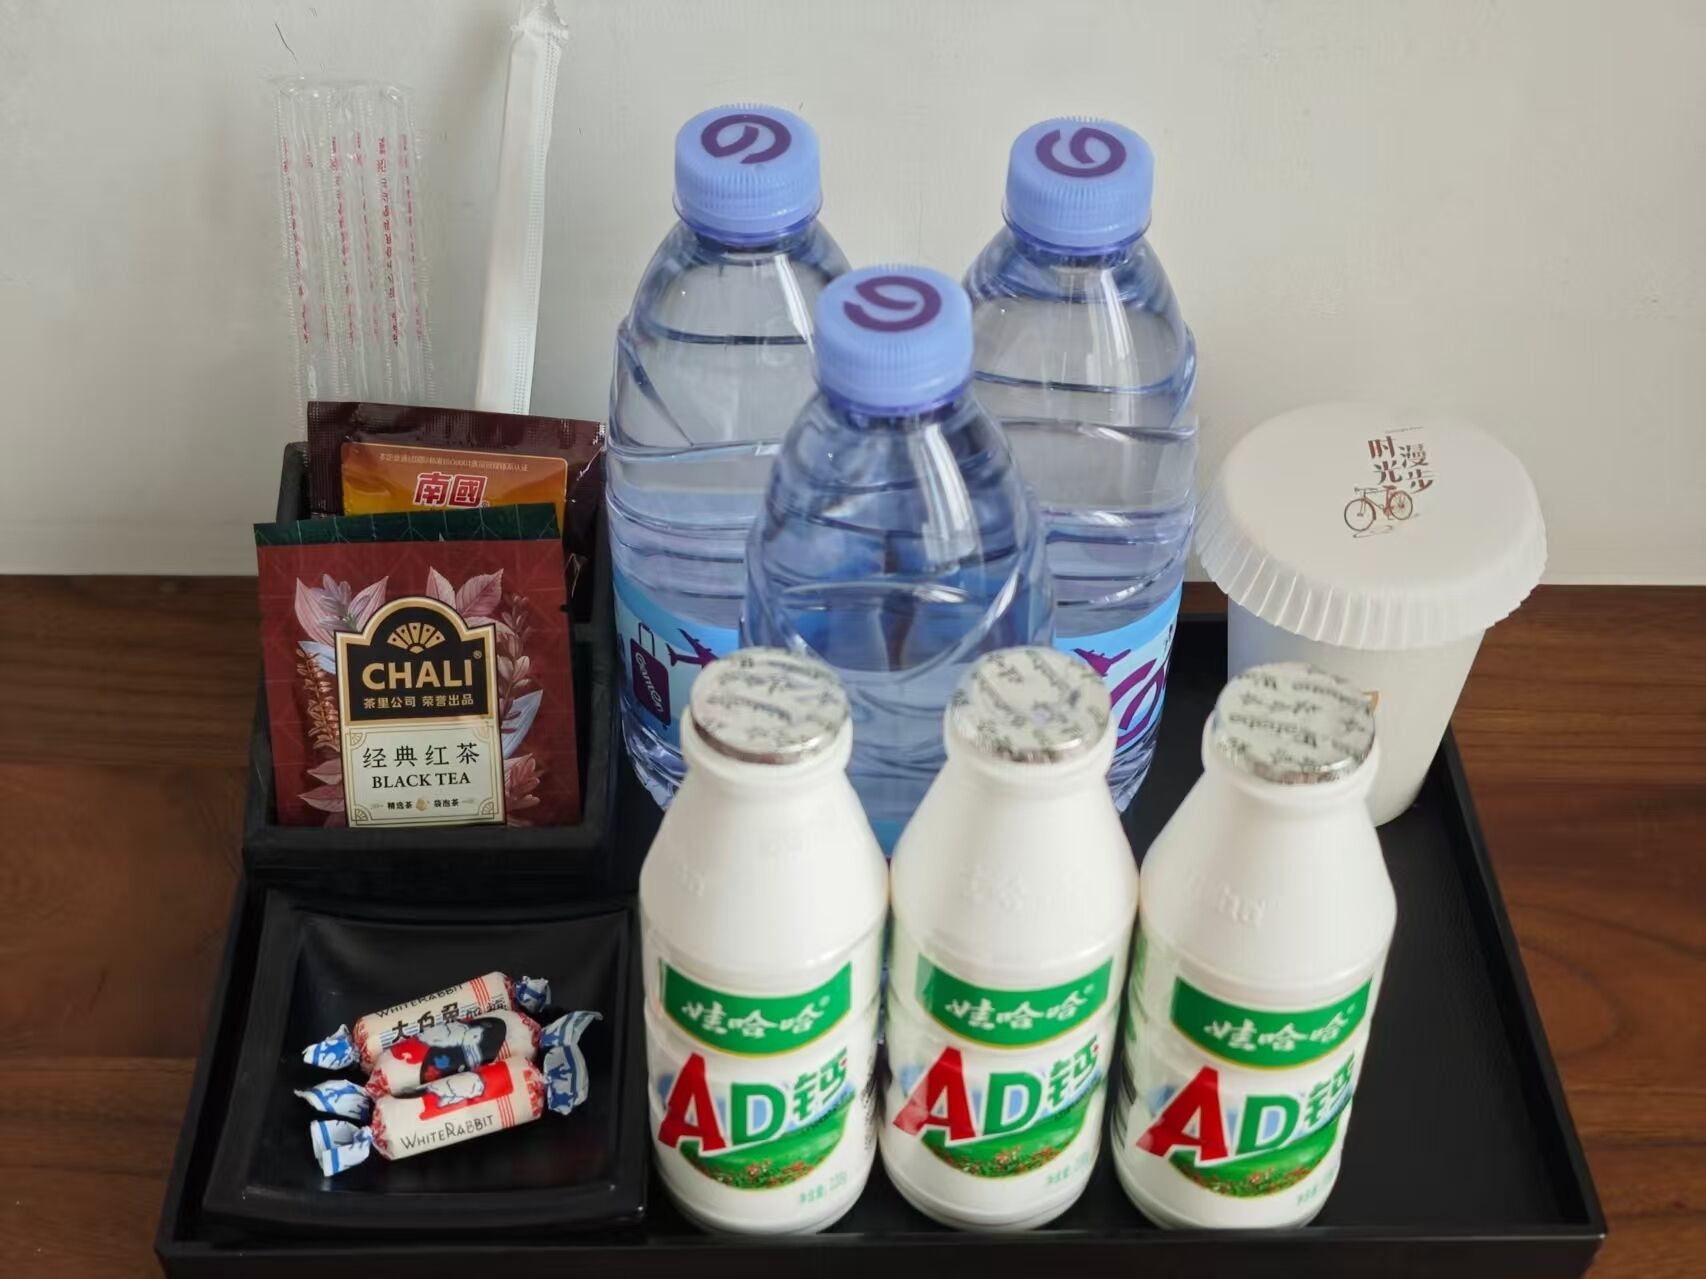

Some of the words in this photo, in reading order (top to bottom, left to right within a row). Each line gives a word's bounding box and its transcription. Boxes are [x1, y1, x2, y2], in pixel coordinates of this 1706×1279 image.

[362, 659, 473, 690] CHALI
[363, 696, 416, 709] 茶里公司
[422, 693, 474, 708] 荣誉出品
[362, 742, 480, 769] 经典红茶
[372, 773, 432, 789] BLACK
[435, 771, 471, 786] TEA
[681, 999, 824, 1039] 娃哈哈
[944, 989, 1088, 1030] 娃哈哈
[1203, 1010, 1350, 1051] 娃哈哈
